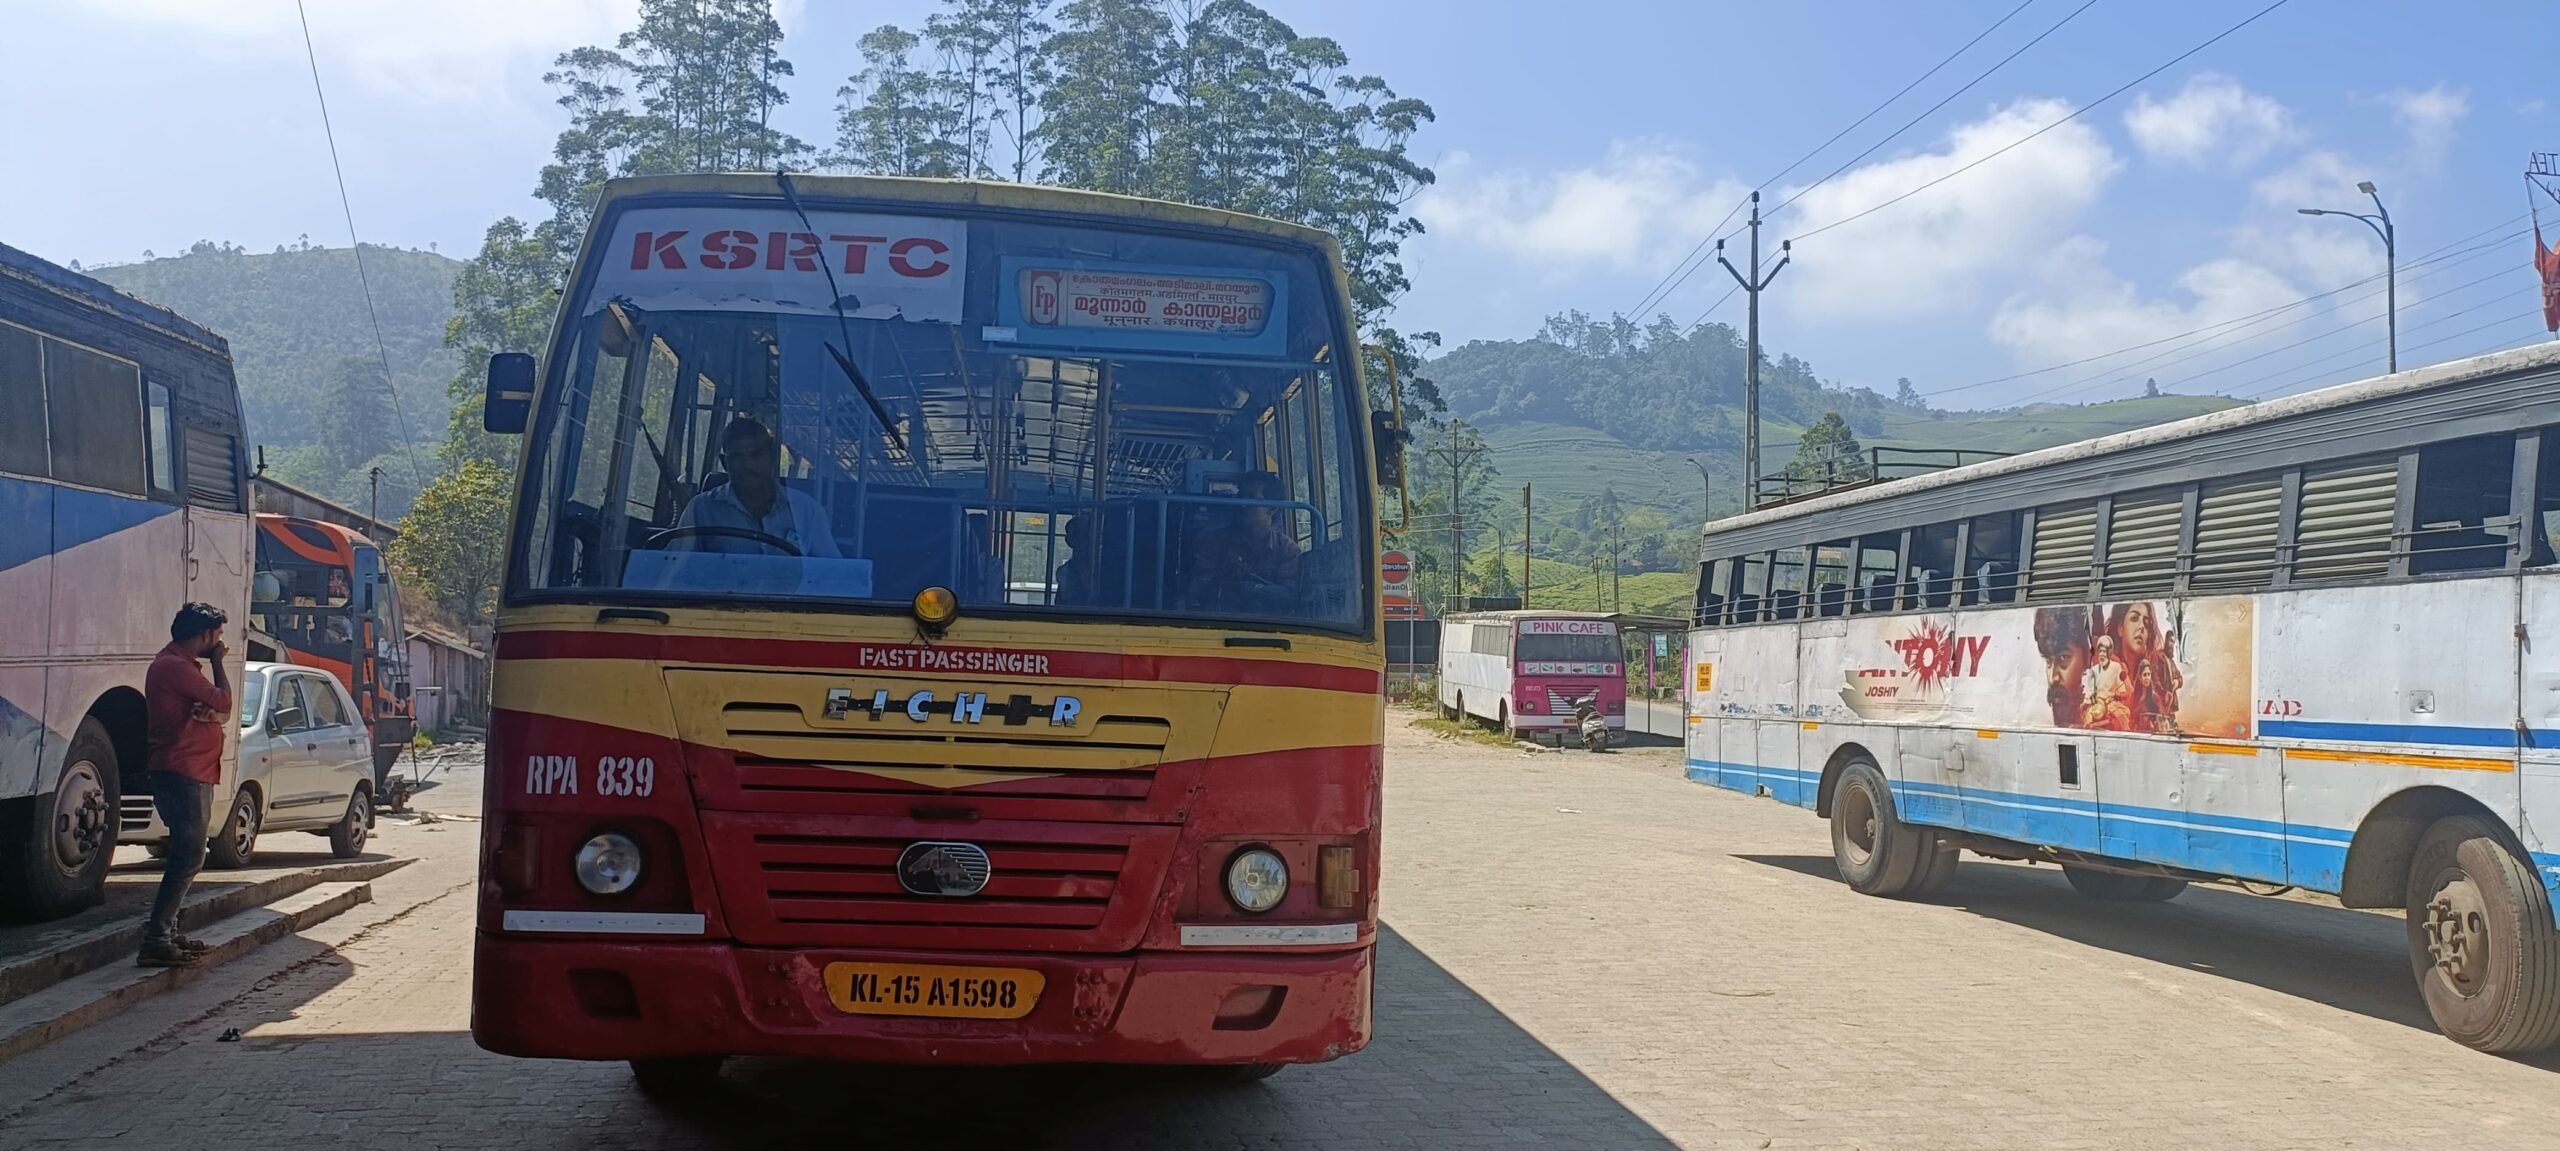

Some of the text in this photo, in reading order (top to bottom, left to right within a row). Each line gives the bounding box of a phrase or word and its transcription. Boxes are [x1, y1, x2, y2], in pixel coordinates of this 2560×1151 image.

[630, 230, 950, 278] KSRTC
[1533, 622, 1604, 634] PINK CAFE
[1858, 636, 1992, 678] TONY
[823, 688, 1081, 727] EICHR
[1864, 686, 1899, 698] JOSHIY
[2258, 699, 2302, 717] AD
[526, 755, 654, 797] RPA 839
[850, 974, 920, 1004] KL-15
